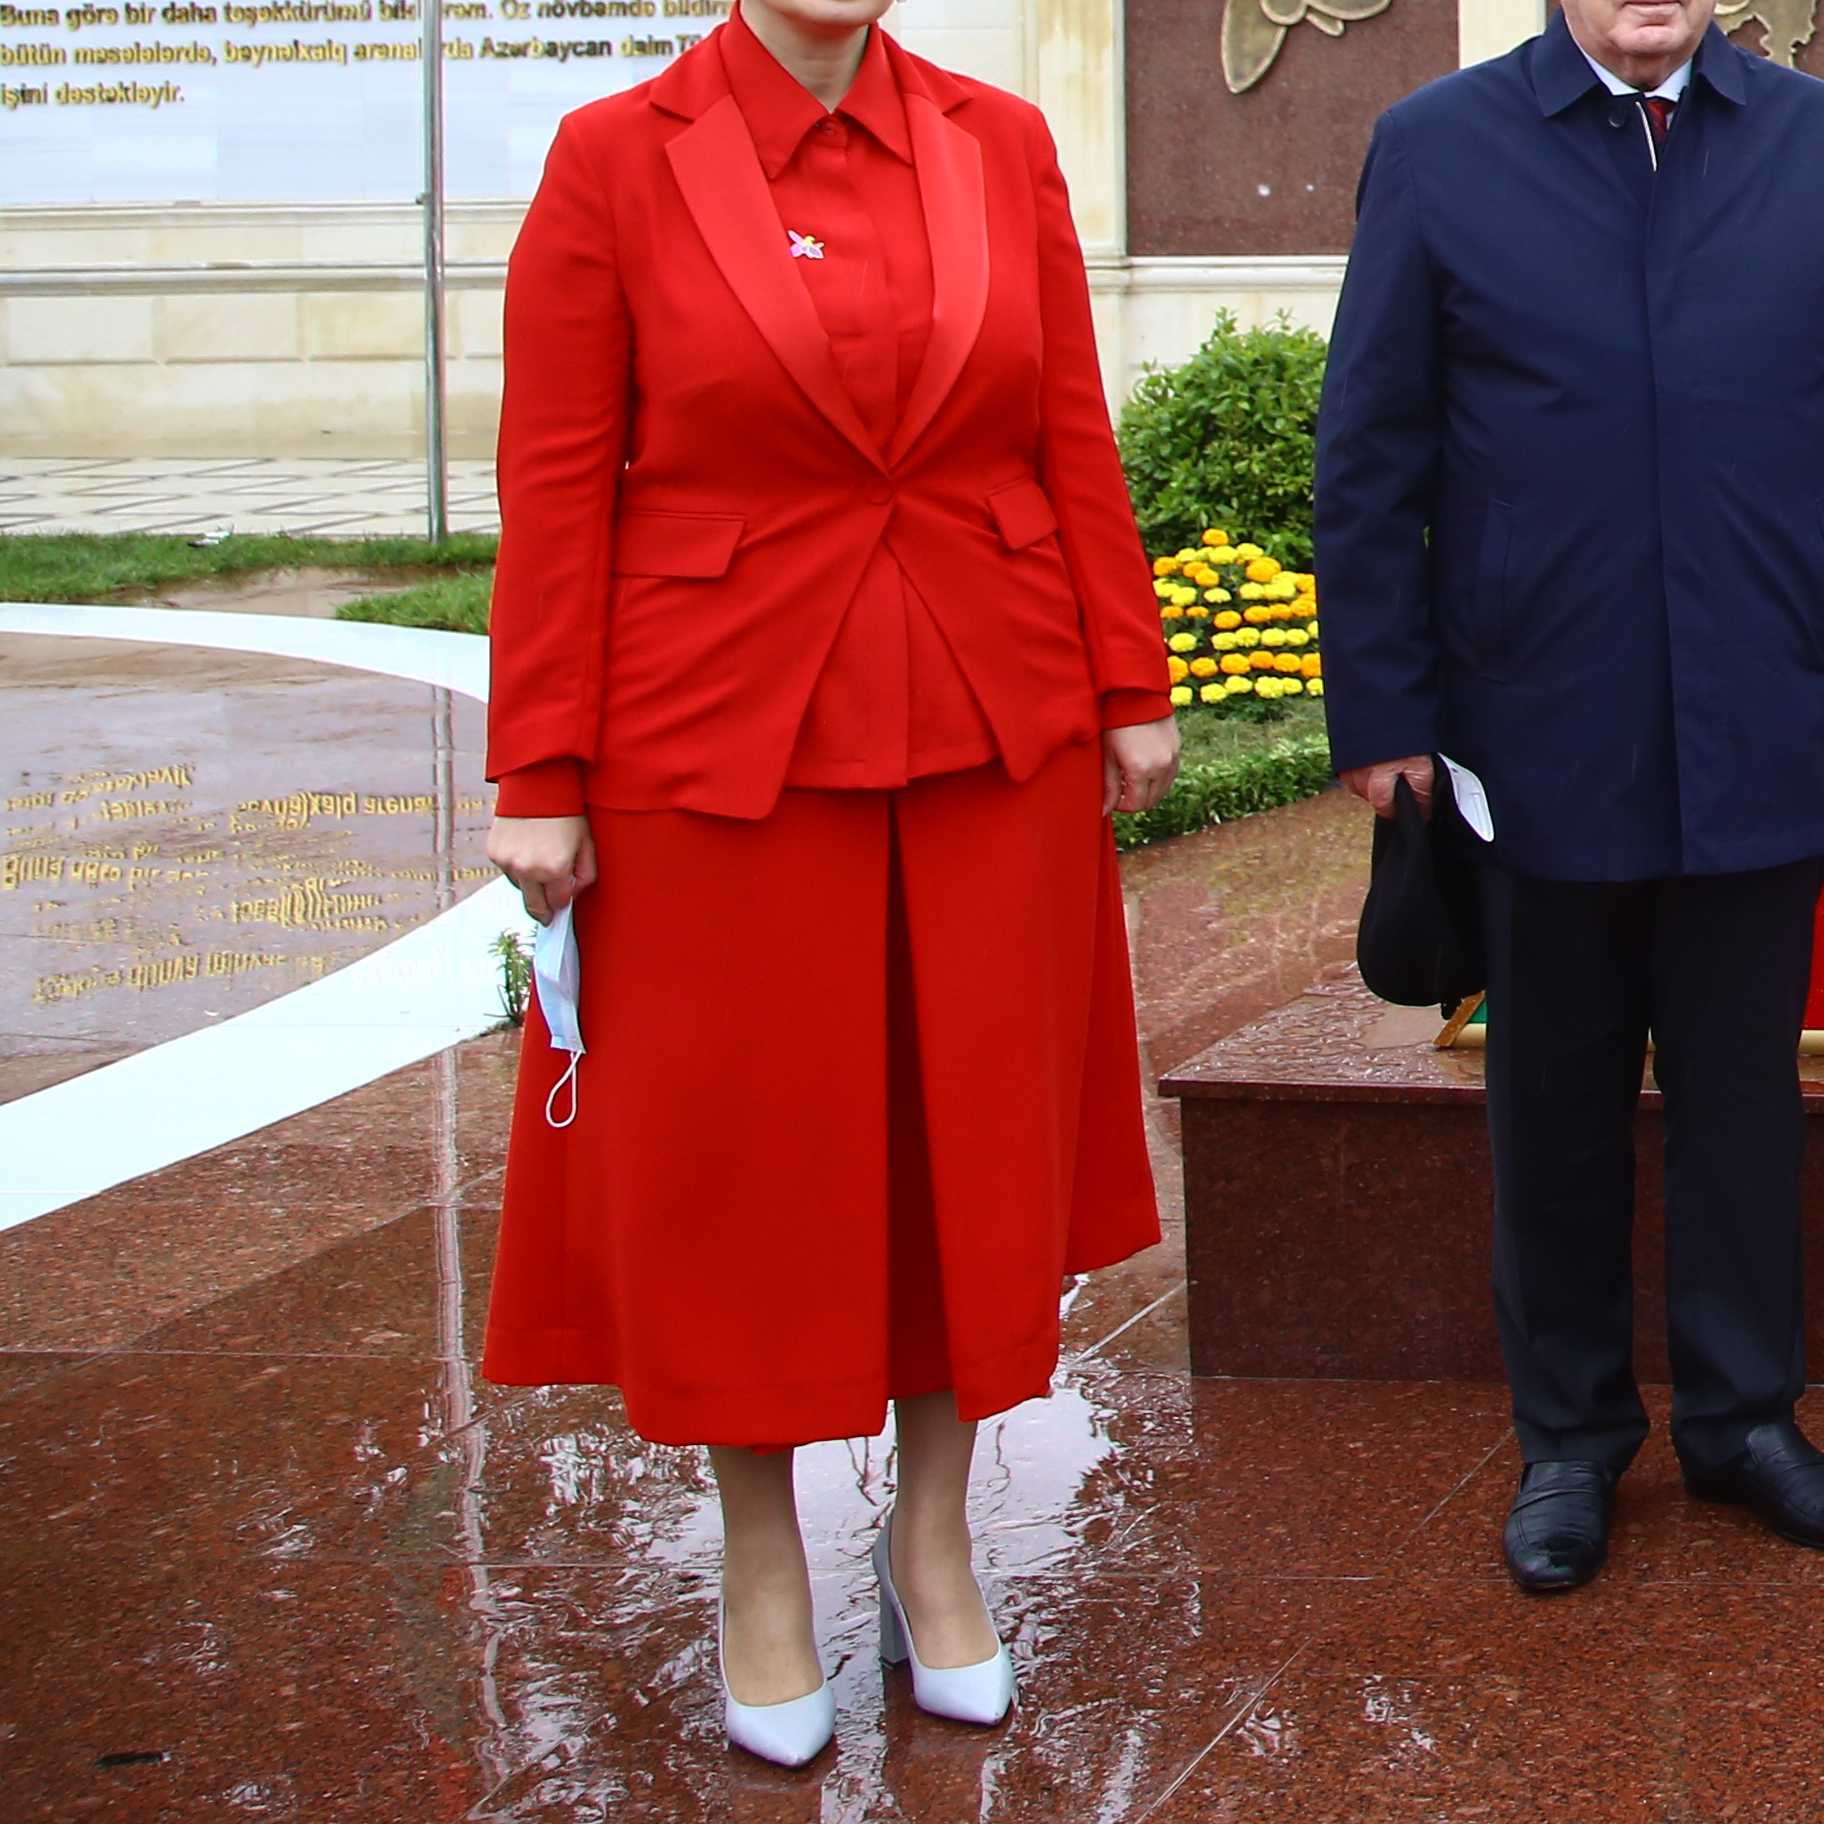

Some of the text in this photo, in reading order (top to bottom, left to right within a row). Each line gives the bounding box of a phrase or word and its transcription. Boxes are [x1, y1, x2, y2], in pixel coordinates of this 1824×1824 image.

[0, 4, 60, 25] Buna
[124, 2, 157, 24] bir
[161, 1, 217, 24] daha
[0, 43, 66, 65] bütün
[479, 35, 612, 63] Azərbaycan
[619, 34, 673, 57] daim
